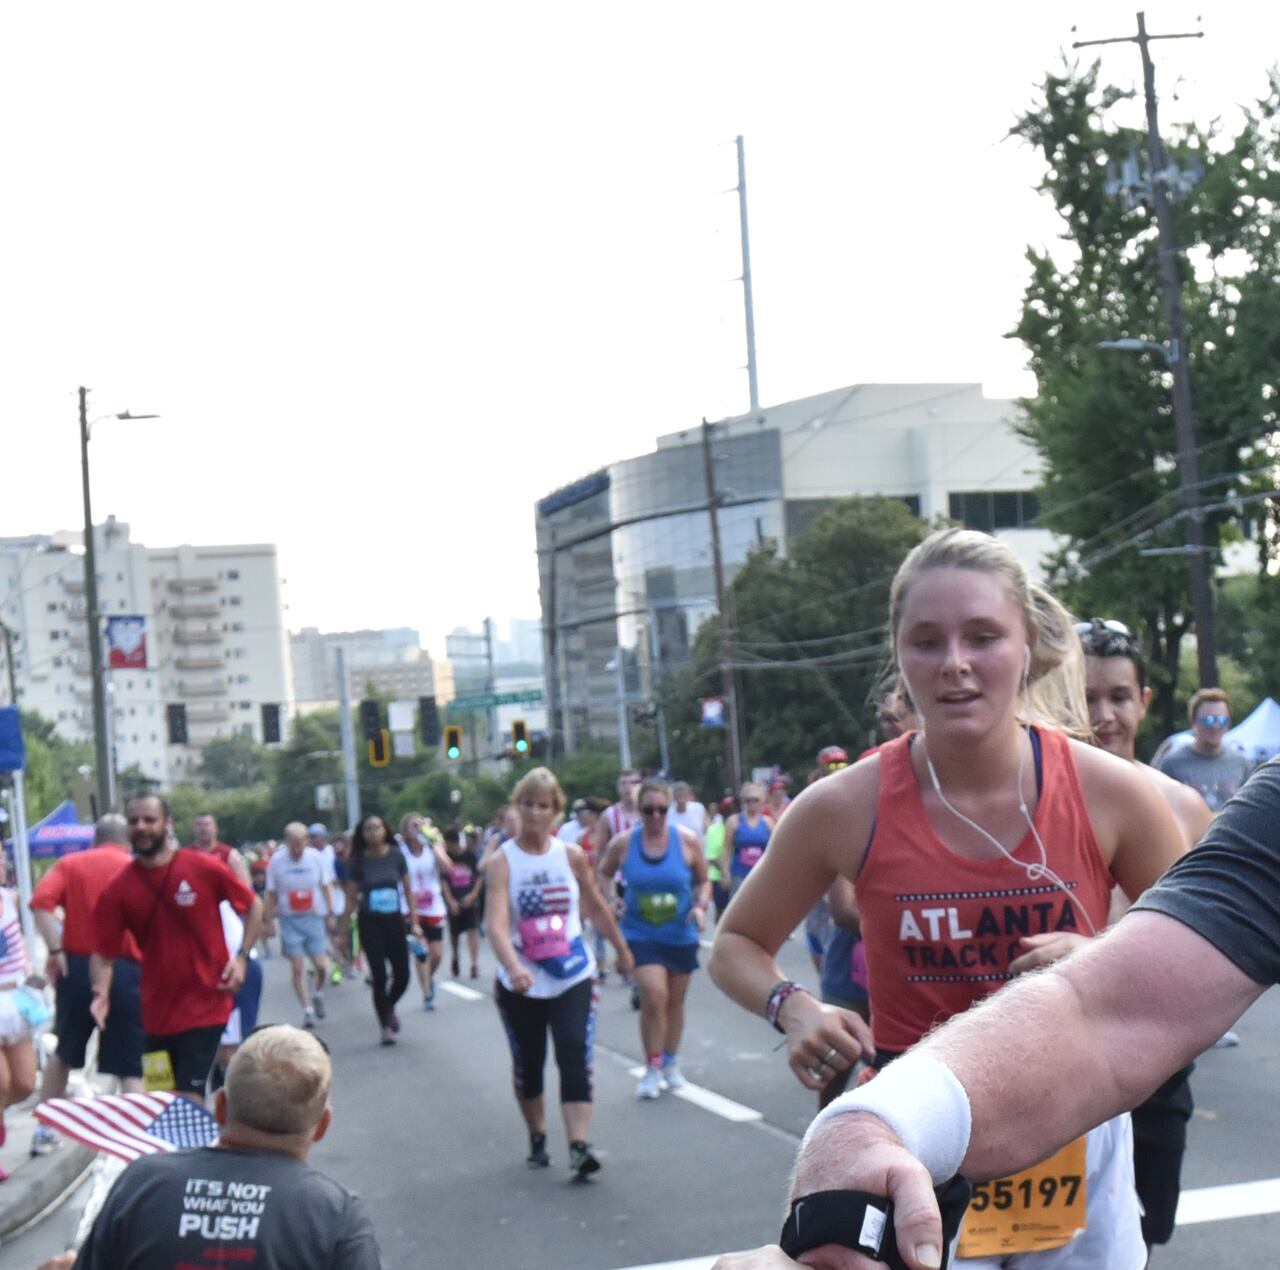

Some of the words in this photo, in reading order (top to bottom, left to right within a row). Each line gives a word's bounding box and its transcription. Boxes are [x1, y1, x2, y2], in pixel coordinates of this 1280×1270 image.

[898, 898, 1077, 942] ATLANTA
[903, 943, 999, 969] TRACK
[227, 1182, 271, 1201] NOT
[970, 1175, 1082, 1212] 55197
[183, 1196, 229, 1213] WHAT
[230, 1200, 265, 1215] YOU
[179, 1213, 260, 1240] PUSH
